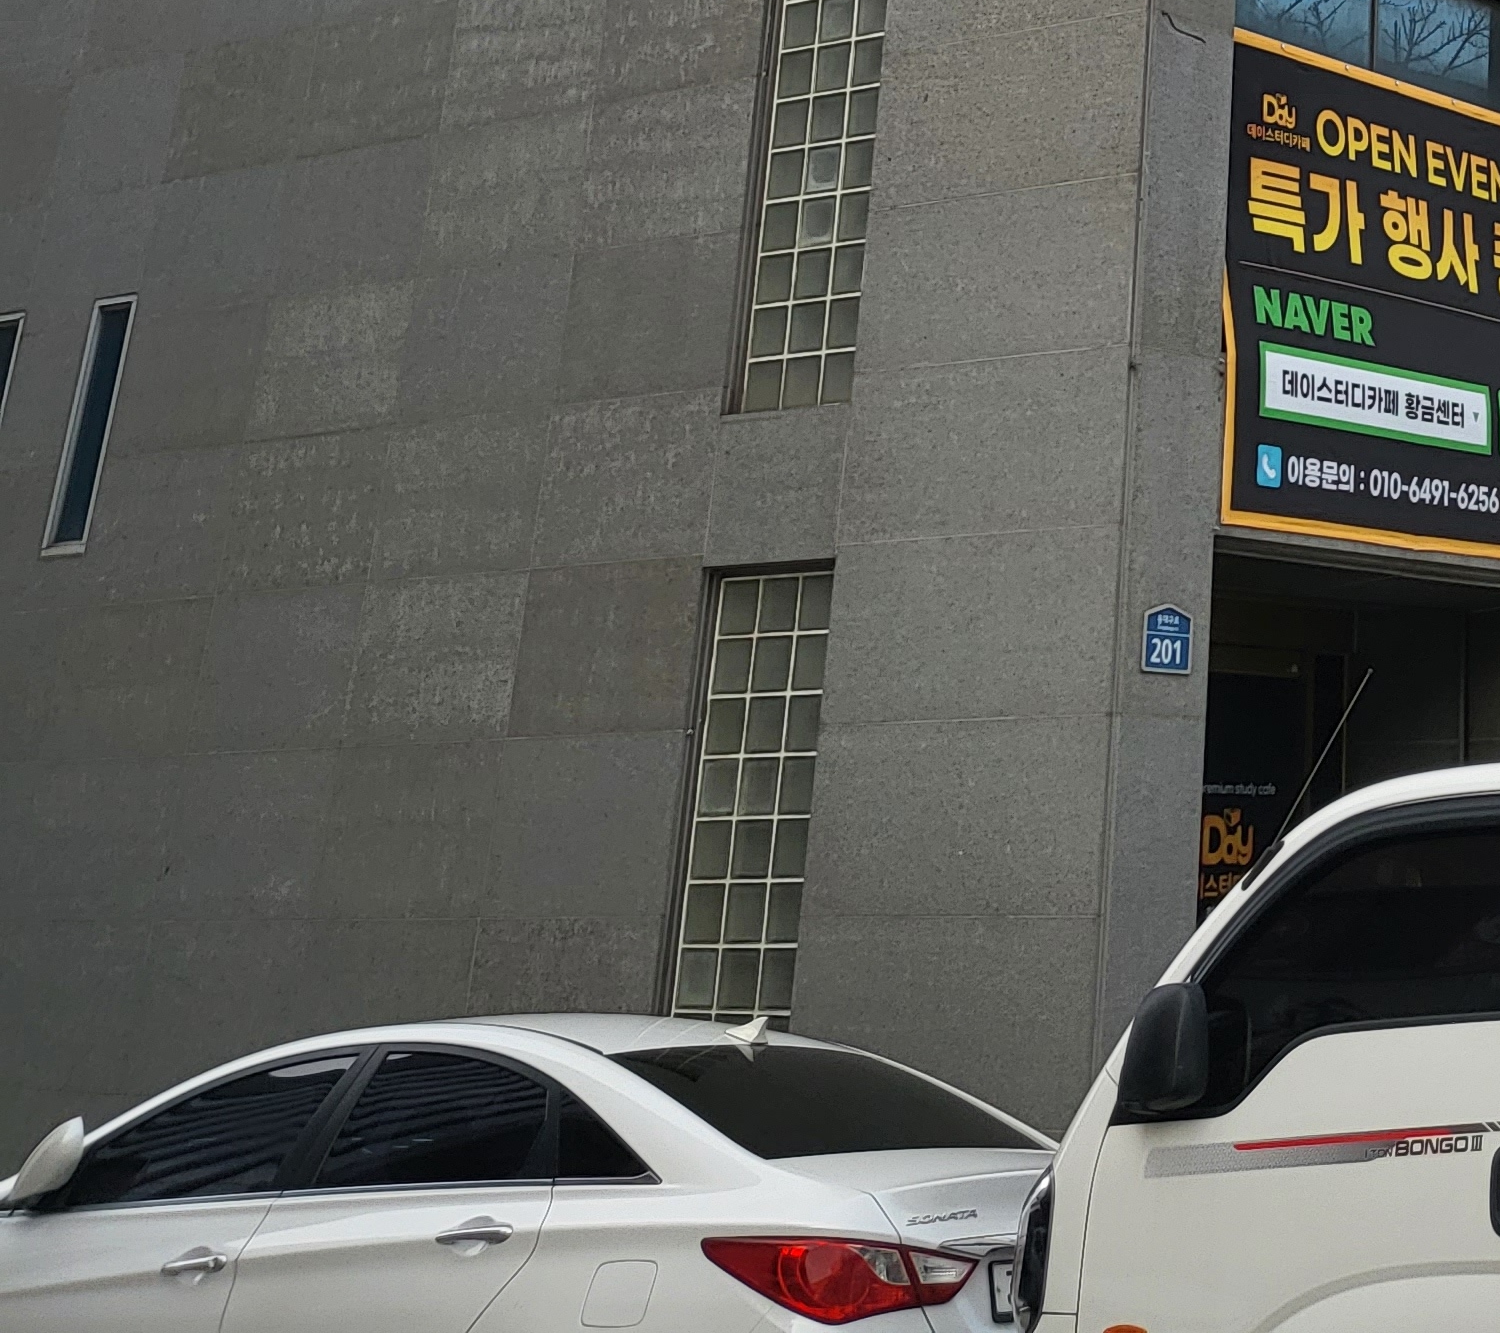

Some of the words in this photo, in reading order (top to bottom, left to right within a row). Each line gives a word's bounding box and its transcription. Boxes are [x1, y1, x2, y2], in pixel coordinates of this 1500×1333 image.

[1262, 93, 1296, 129] Day
[1247, 123, 1311, 152] 데이스터디카페
[1316, 109, 1418, 178] OPEN
[1247, 156, 1365, 266] 특가
[1379, 188, 1480, 294] 행사
[1253, 285, 1376, 347] NAVER
[1282, 369, 1399, 417] 데이스터디카페
[1404, 391, 1465, 429] 황금센터
[1369, 468, 1499, 514] 010-6491-6256
[1150, 637, 1181, 665] 201
[1395, 1135, 1468, 1157] BONGO
[906, 1208, 978, 1227] SONATA
